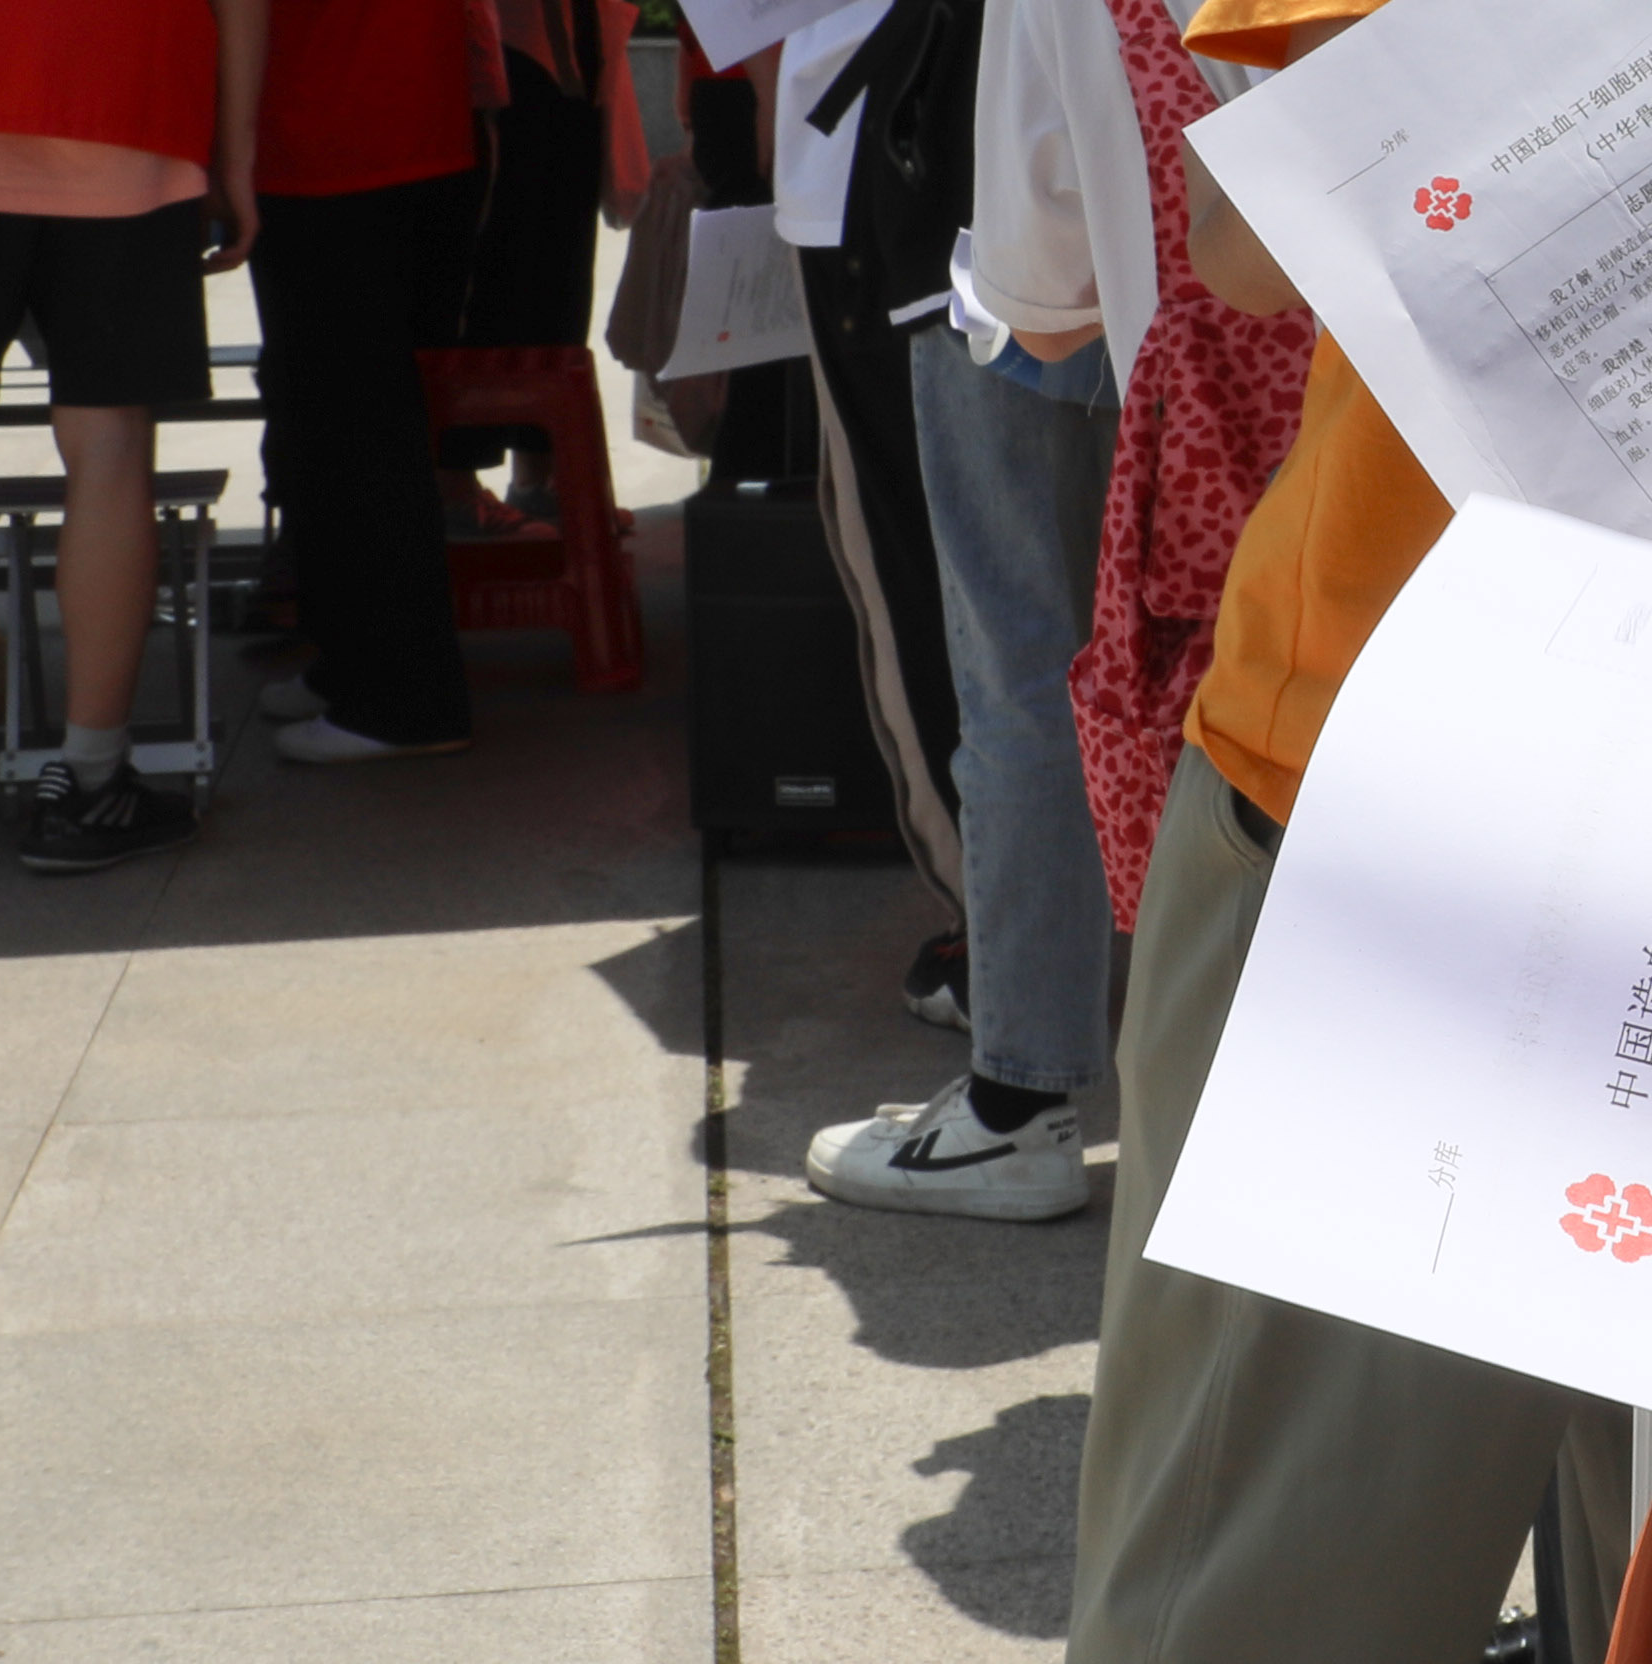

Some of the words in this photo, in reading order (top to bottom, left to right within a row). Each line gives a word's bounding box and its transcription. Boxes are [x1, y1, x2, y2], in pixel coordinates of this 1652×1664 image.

[1376, 125, 1412, 157] 分库
[1545, 265, 1595, 307] 我了解
[1558, 342, 1601, 379] 症等。
[1598, 335, 1648, 377] 我清楚
[1429, 1138, 1463, 1192] 分库
